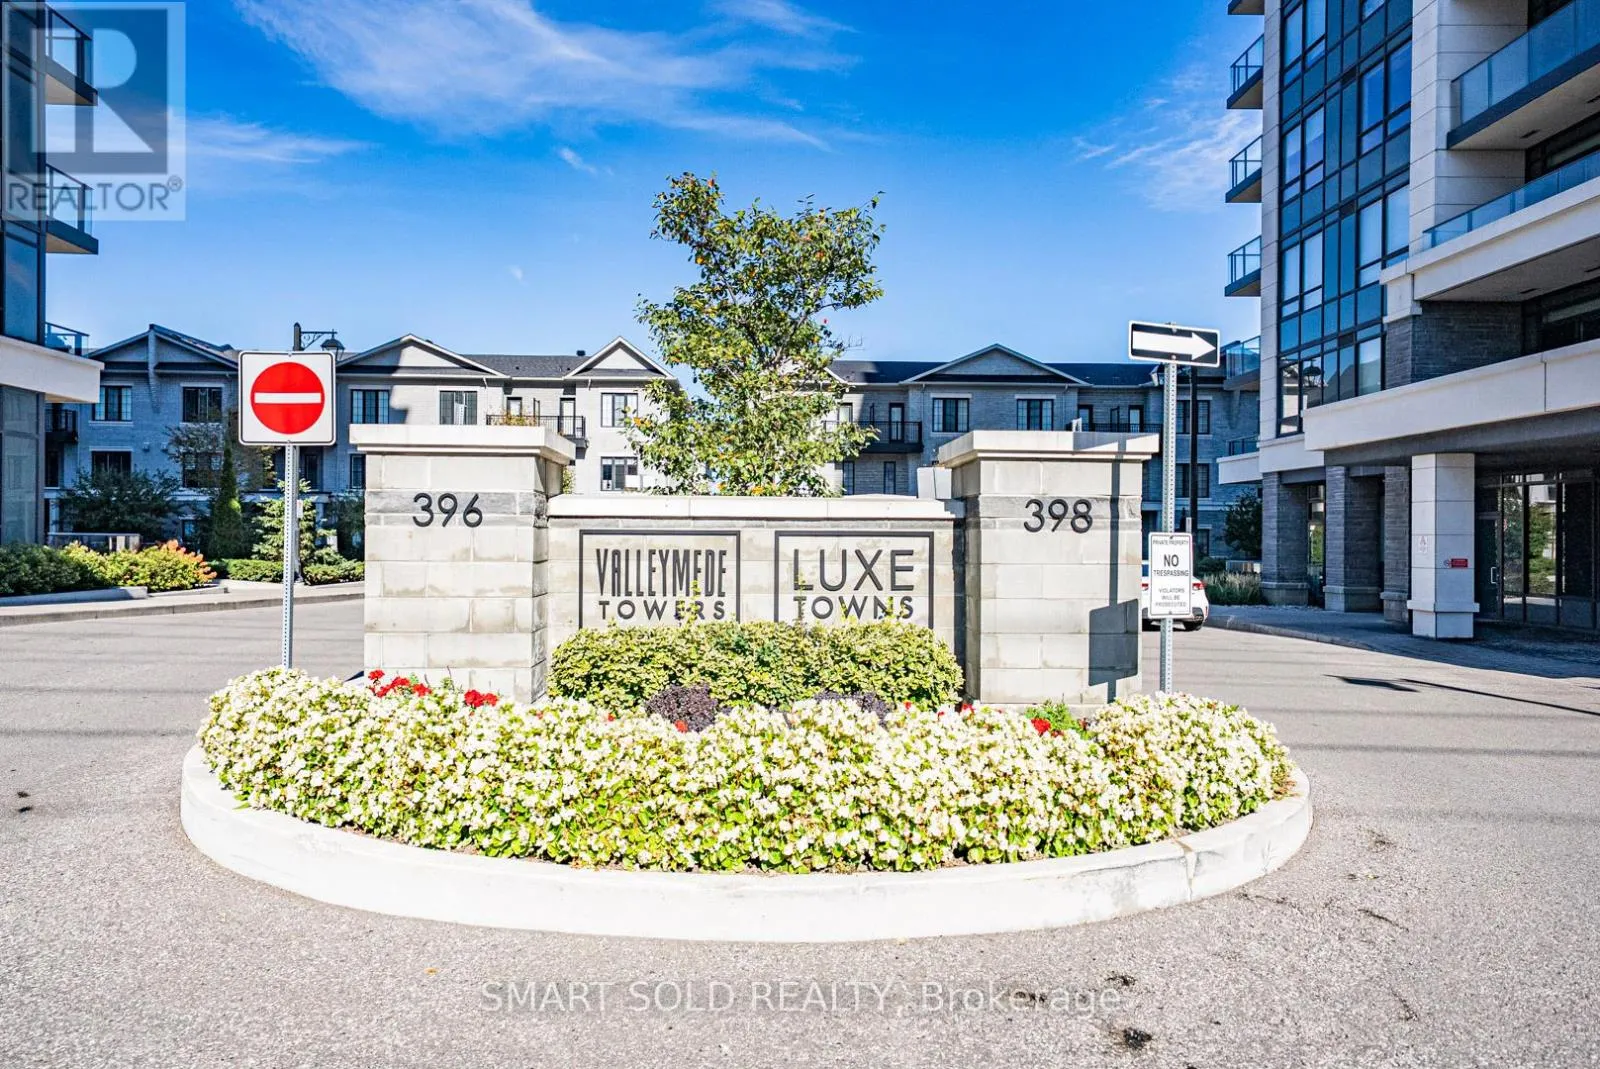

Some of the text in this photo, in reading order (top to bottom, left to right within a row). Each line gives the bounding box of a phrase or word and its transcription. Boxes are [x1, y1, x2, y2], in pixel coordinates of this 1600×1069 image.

[412, 492, 483, 528] 396
[1023, 498, 1093, 534] 398
[596, 548, 728, 597] VALLEYMEDE
[793, 548, 915, 592] LUXE
[1163, 554, 1179, 567] NO
[793, 595, 914, 620] TOWNS
